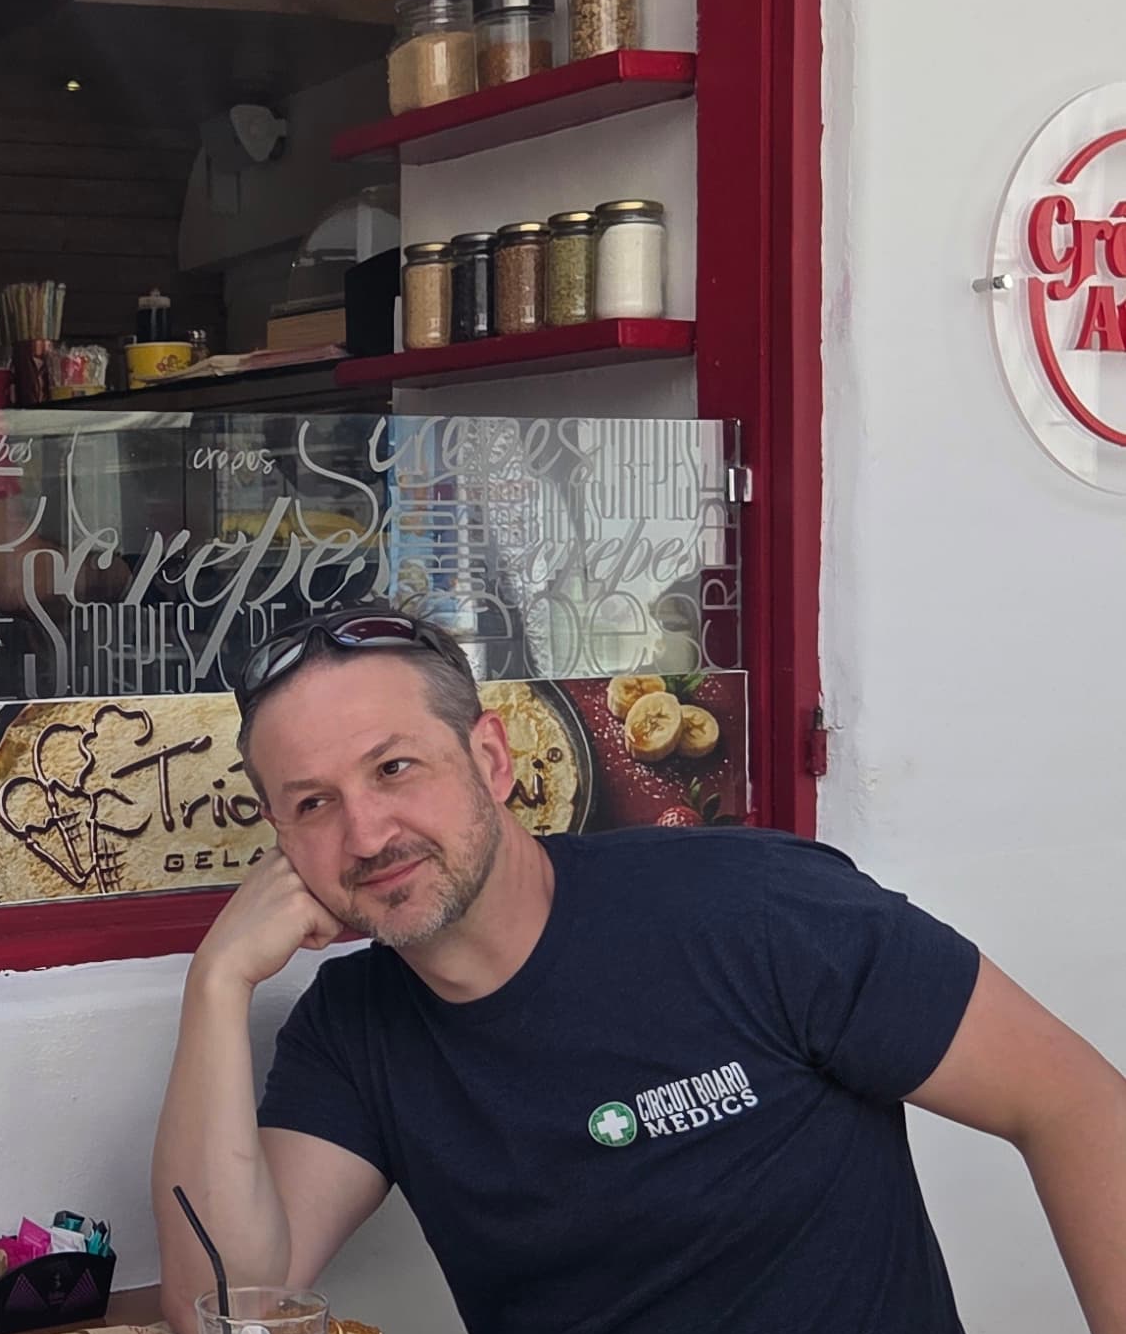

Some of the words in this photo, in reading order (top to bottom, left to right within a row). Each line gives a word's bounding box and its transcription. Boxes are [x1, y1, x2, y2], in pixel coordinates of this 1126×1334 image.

[71, 599, 200, 698] CREPES
[635, 1078, 696, 1122] CIRCUIT
[691, 1061, 750, 1105] BOARD
[644, 1088, 758, 1138] MEDICS
